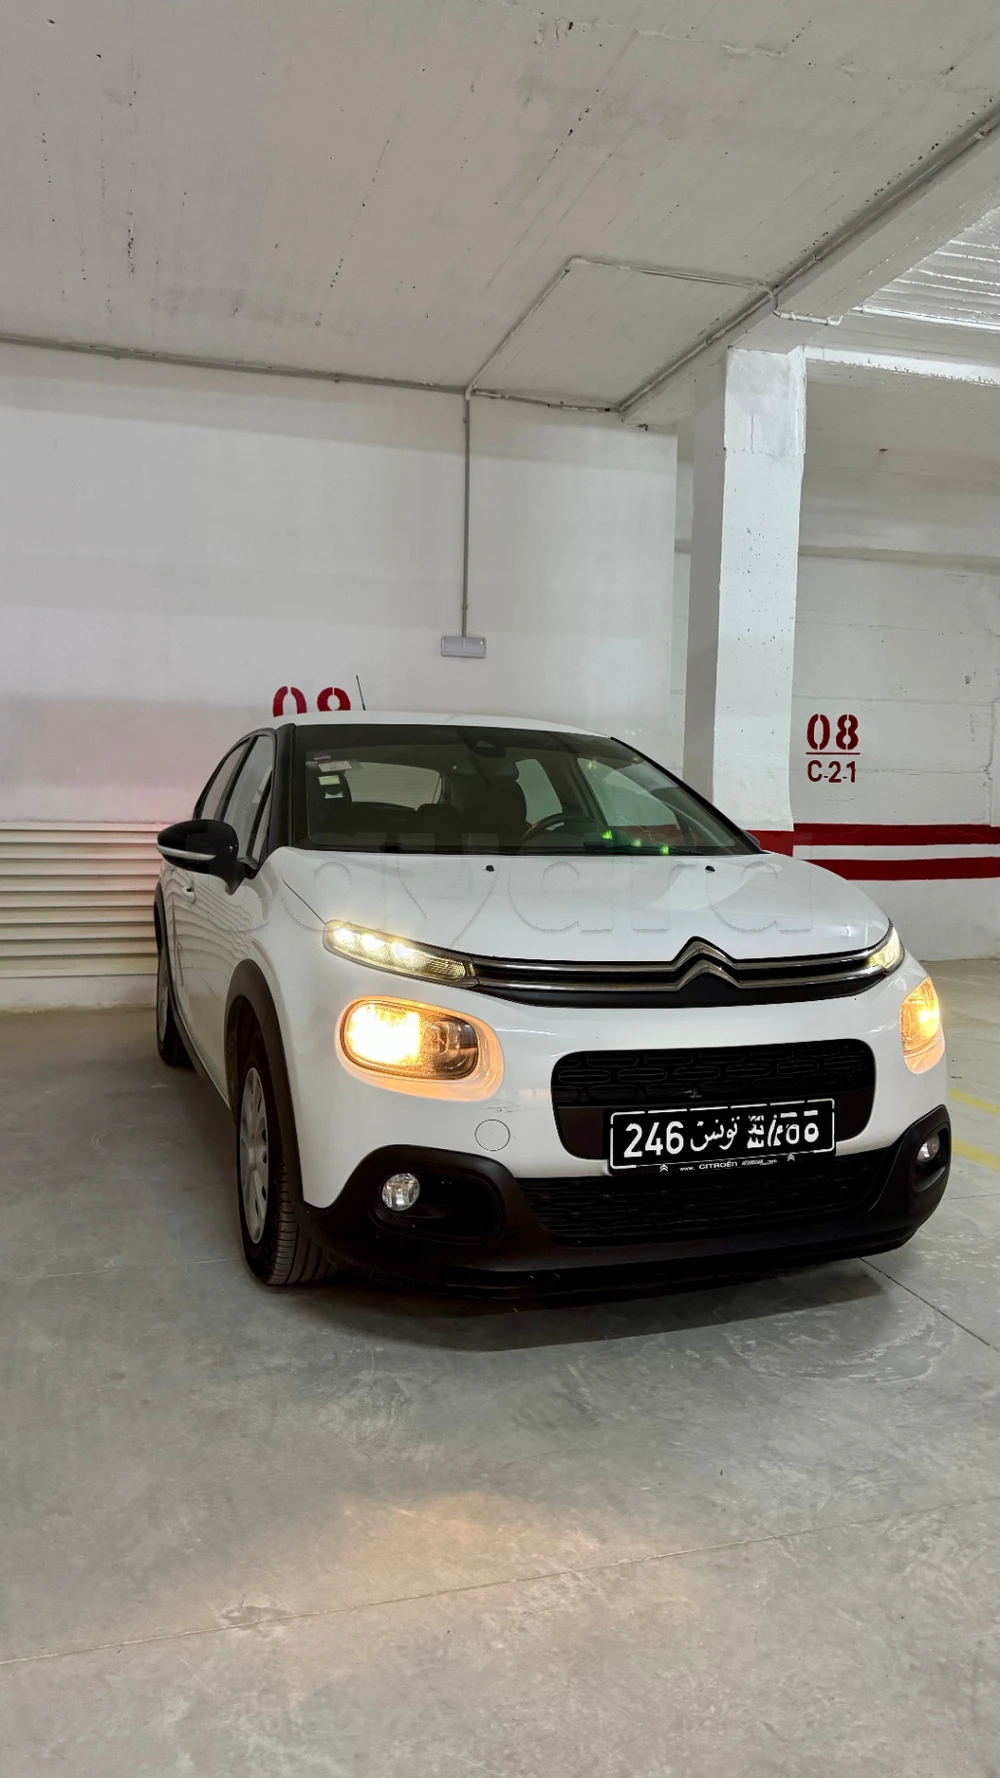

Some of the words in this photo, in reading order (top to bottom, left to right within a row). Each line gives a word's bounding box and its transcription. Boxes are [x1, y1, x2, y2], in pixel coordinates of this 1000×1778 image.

[806, 713, 860, 751] 08
[807, 759, 856, 783] C-2-1
[623, 1120, 684, 1158] 246
[690, 1115, 741, 1151] تونس
